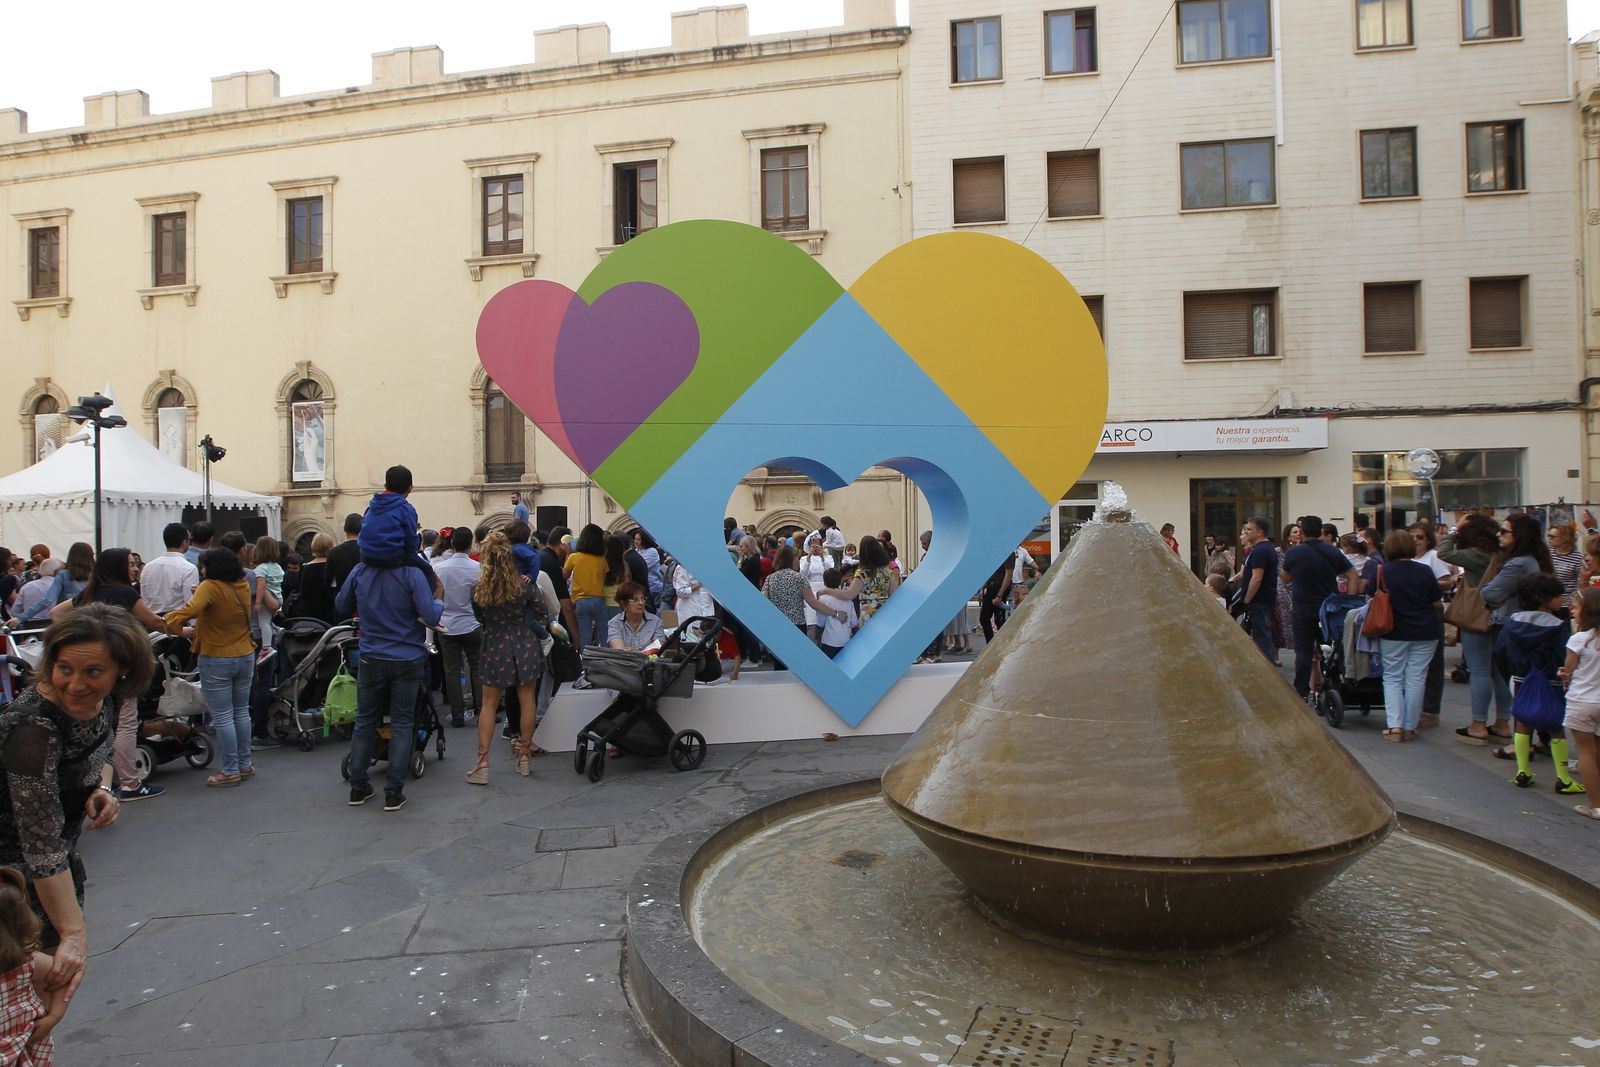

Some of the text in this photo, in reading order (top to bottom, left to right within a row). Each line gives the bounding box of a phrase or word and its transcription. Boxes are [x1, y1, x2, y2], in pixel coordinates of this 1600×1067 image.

[1101, 428, 1153, 442] ARCO
[1215, 427, 1250, 435] Nuestra
[1216, 436, 1224, 444] tu
[1226, 436, 1250, 445] mejor
